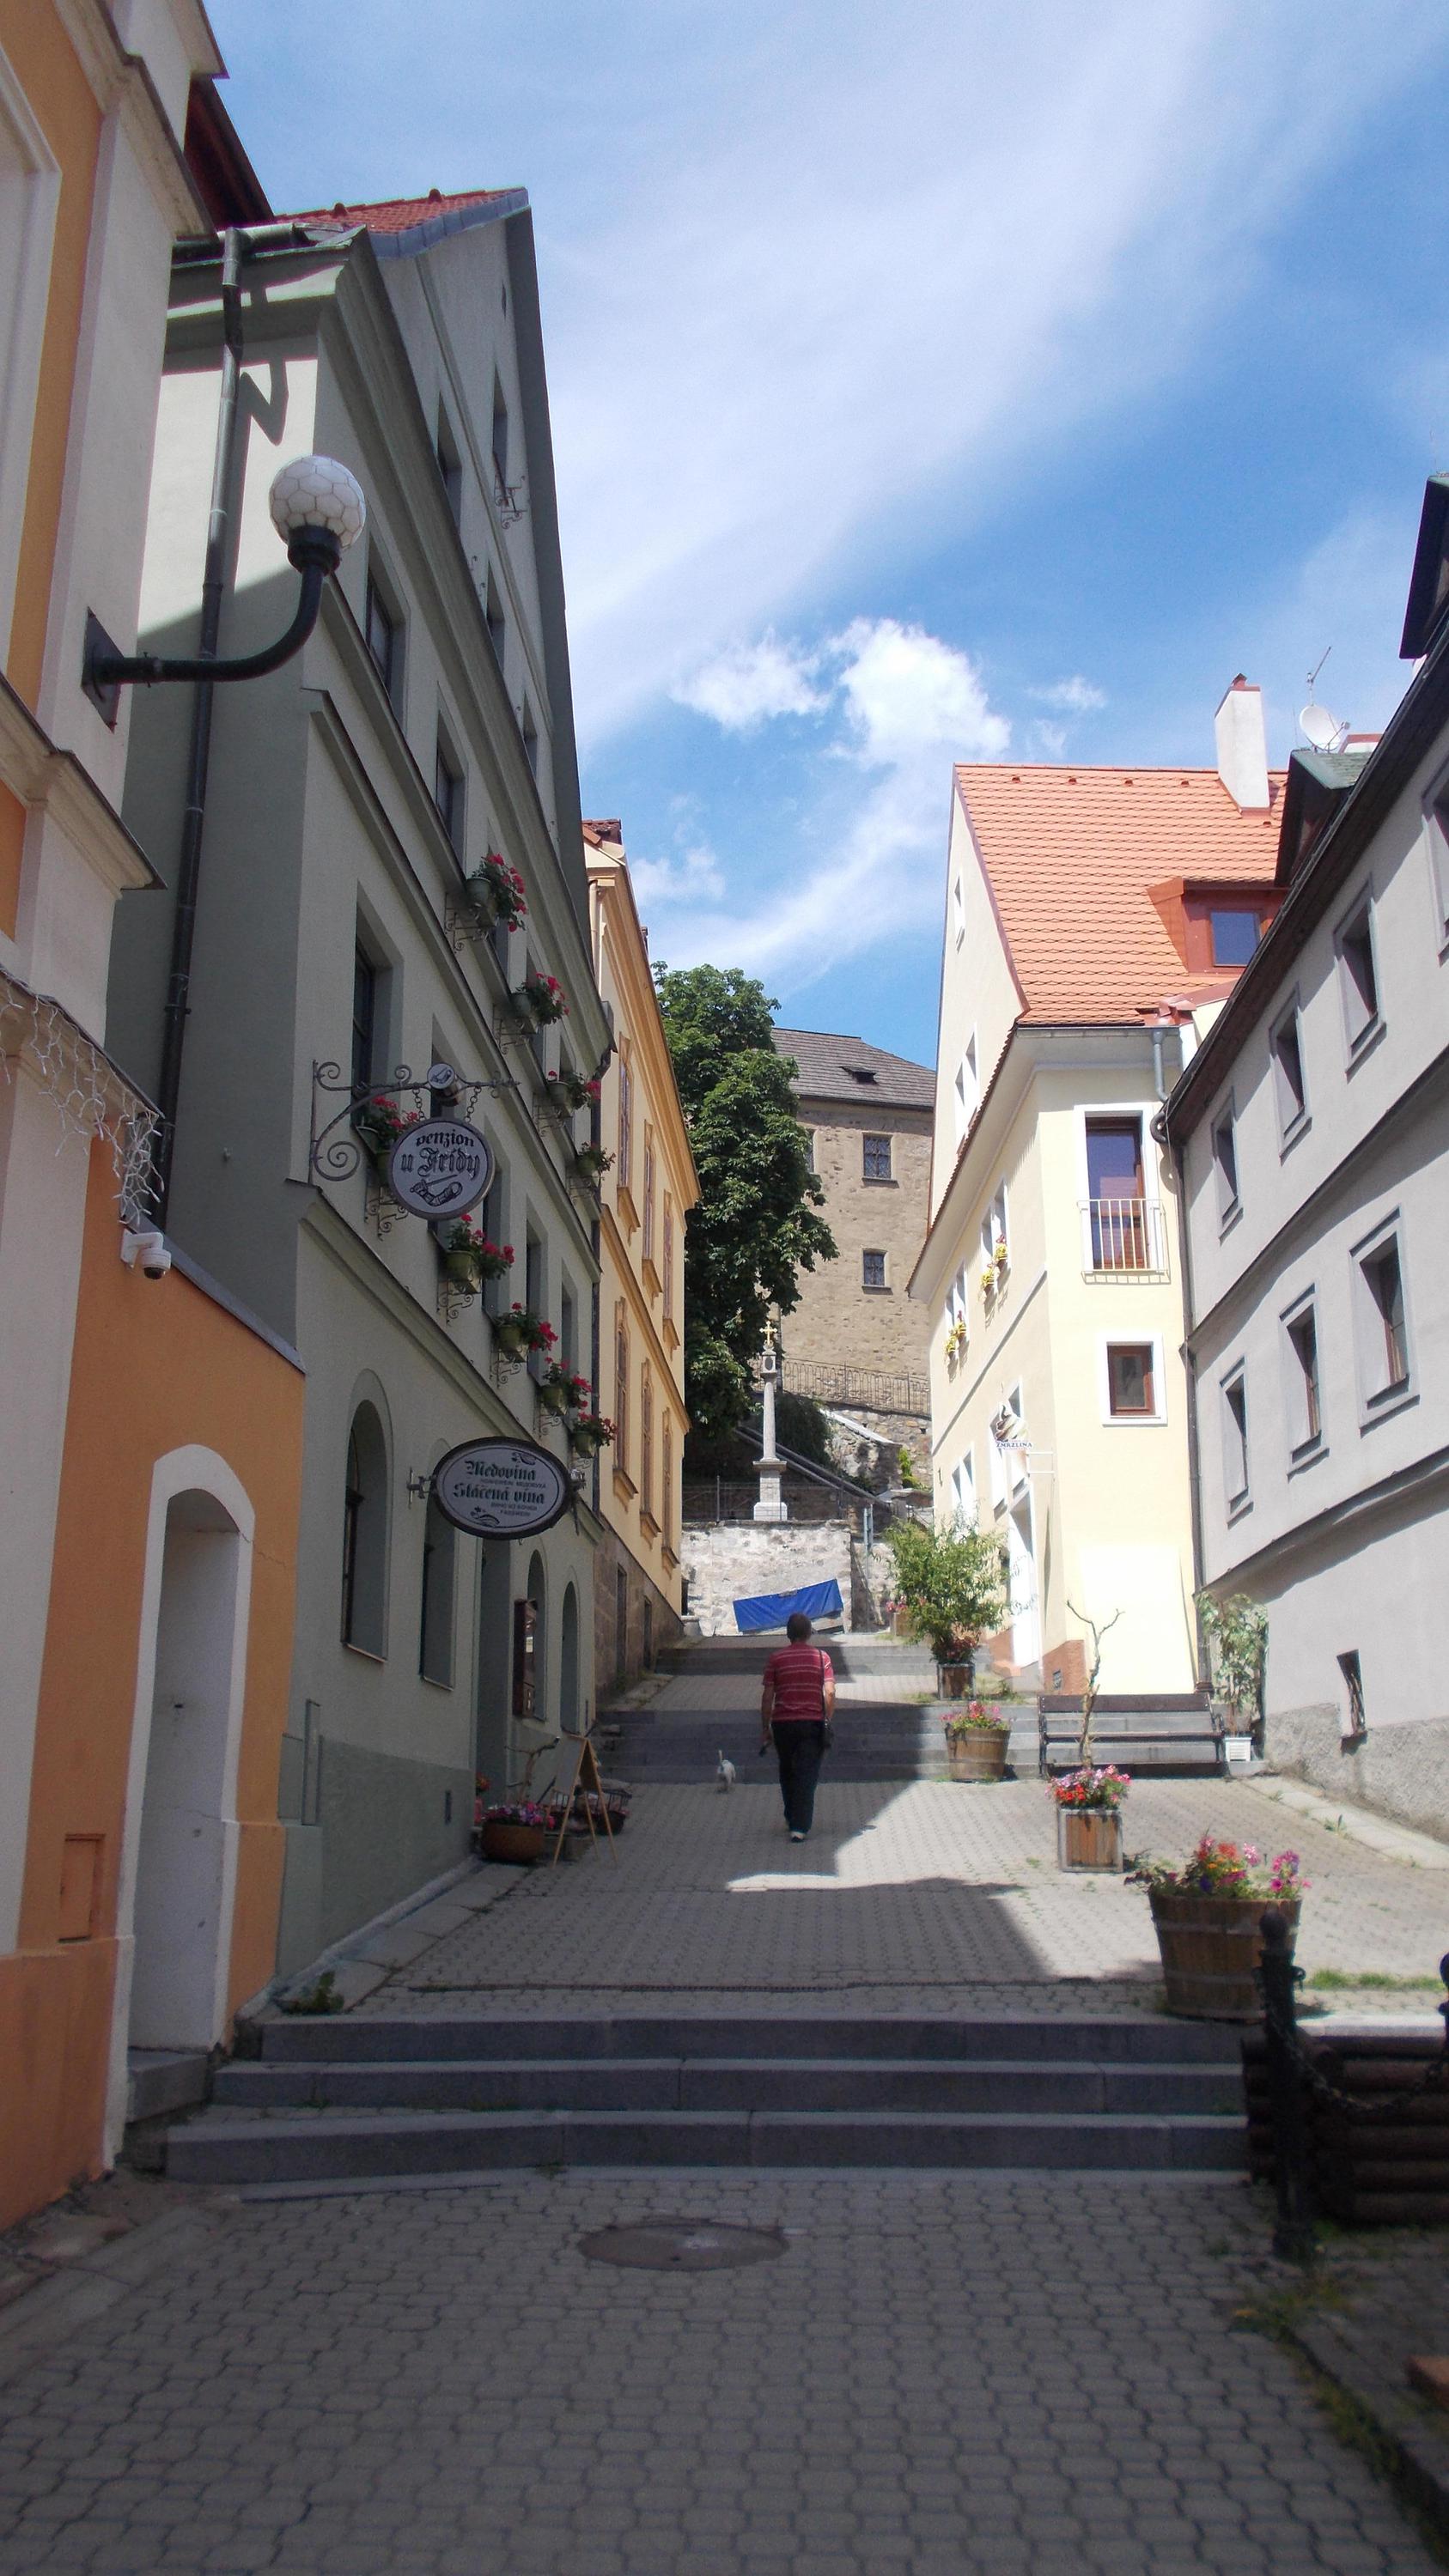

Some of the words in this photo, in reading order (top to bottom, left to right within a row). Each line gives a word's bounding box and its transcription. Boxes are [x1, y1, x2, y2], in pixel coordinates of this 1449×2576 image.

[416, 1129, 474, 1148] penzion
[400, 1153, 413, 1173] u
[465, 1460, 536, 1480] Medovina
